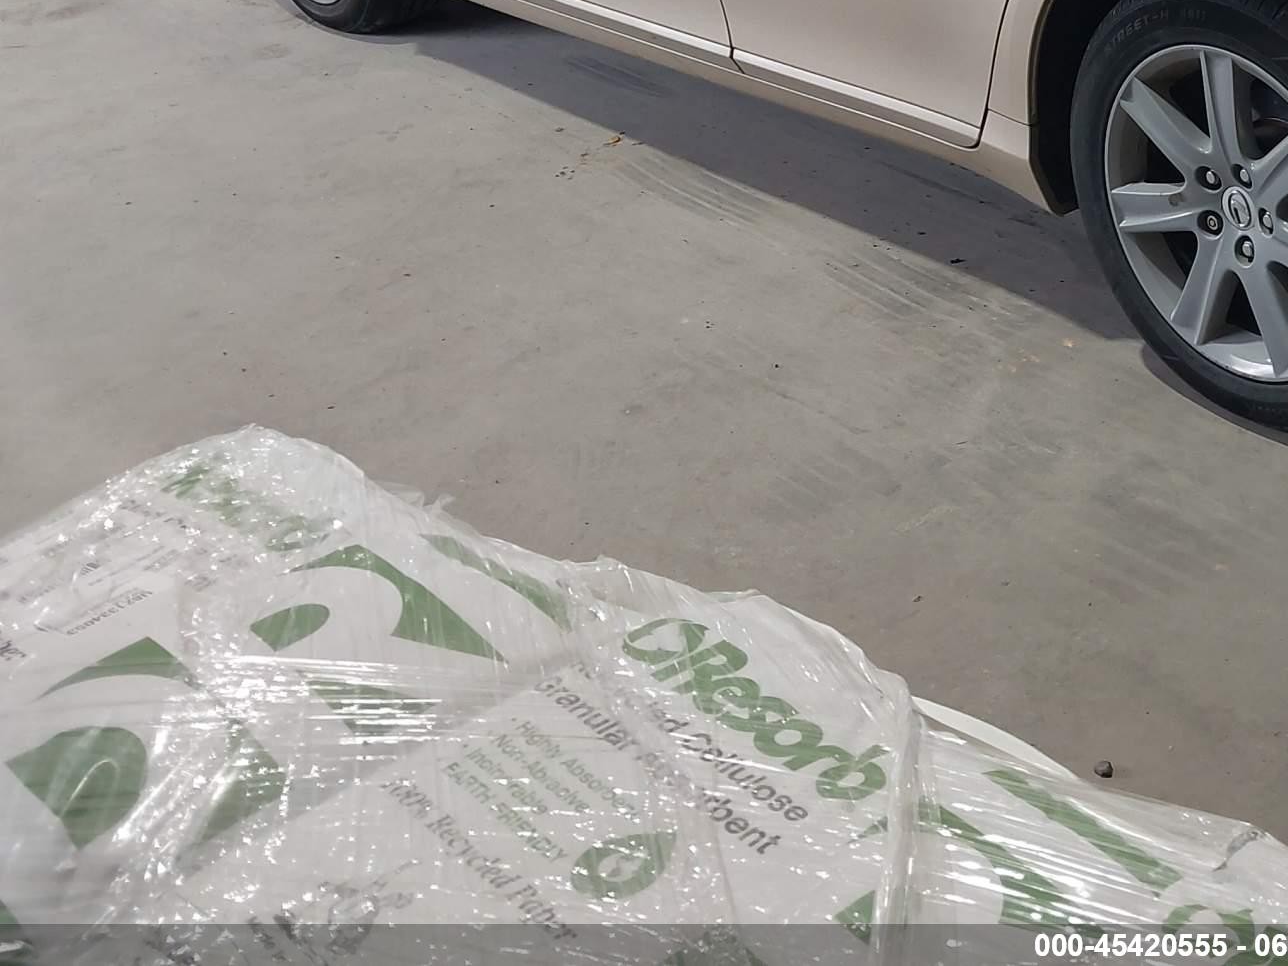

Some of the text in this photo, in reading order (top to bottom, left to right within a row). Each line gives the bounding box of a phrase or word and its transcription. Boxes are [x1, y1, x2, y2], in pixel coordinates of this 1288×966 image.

[534, 675, 640, 752] Granular
[636, 750, 783, 855] rbent
[680, 731, 809, 823] Cellulose
